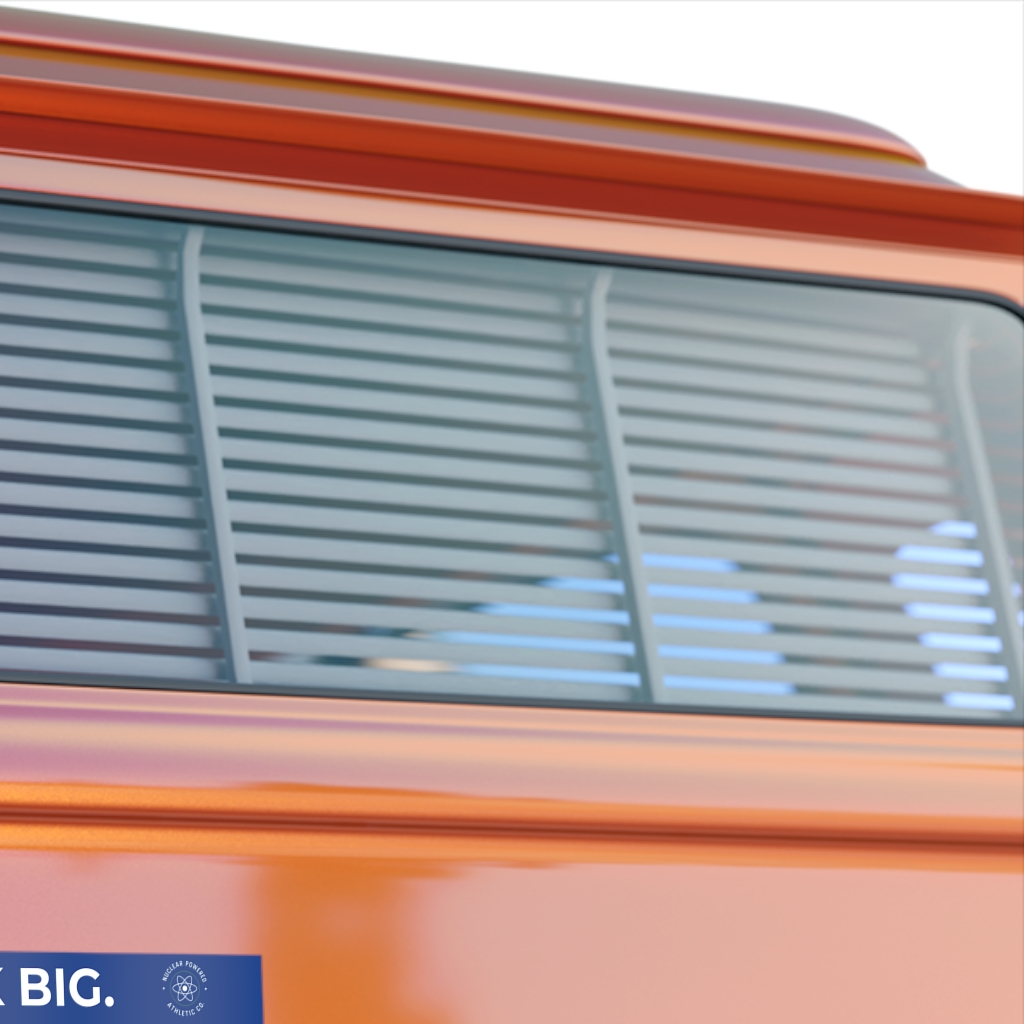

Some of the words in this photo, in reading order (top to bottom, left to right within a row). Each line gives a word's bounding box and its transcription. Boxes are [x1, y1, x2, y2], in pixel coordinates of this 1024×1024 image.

[161, 960, 183, 982] NUCLEAR
[185, 960, 207, 983] POWERED
[20, 967, 115, 1008] BIG.
[167, 1002, 195, 1017] ATHLETIC
